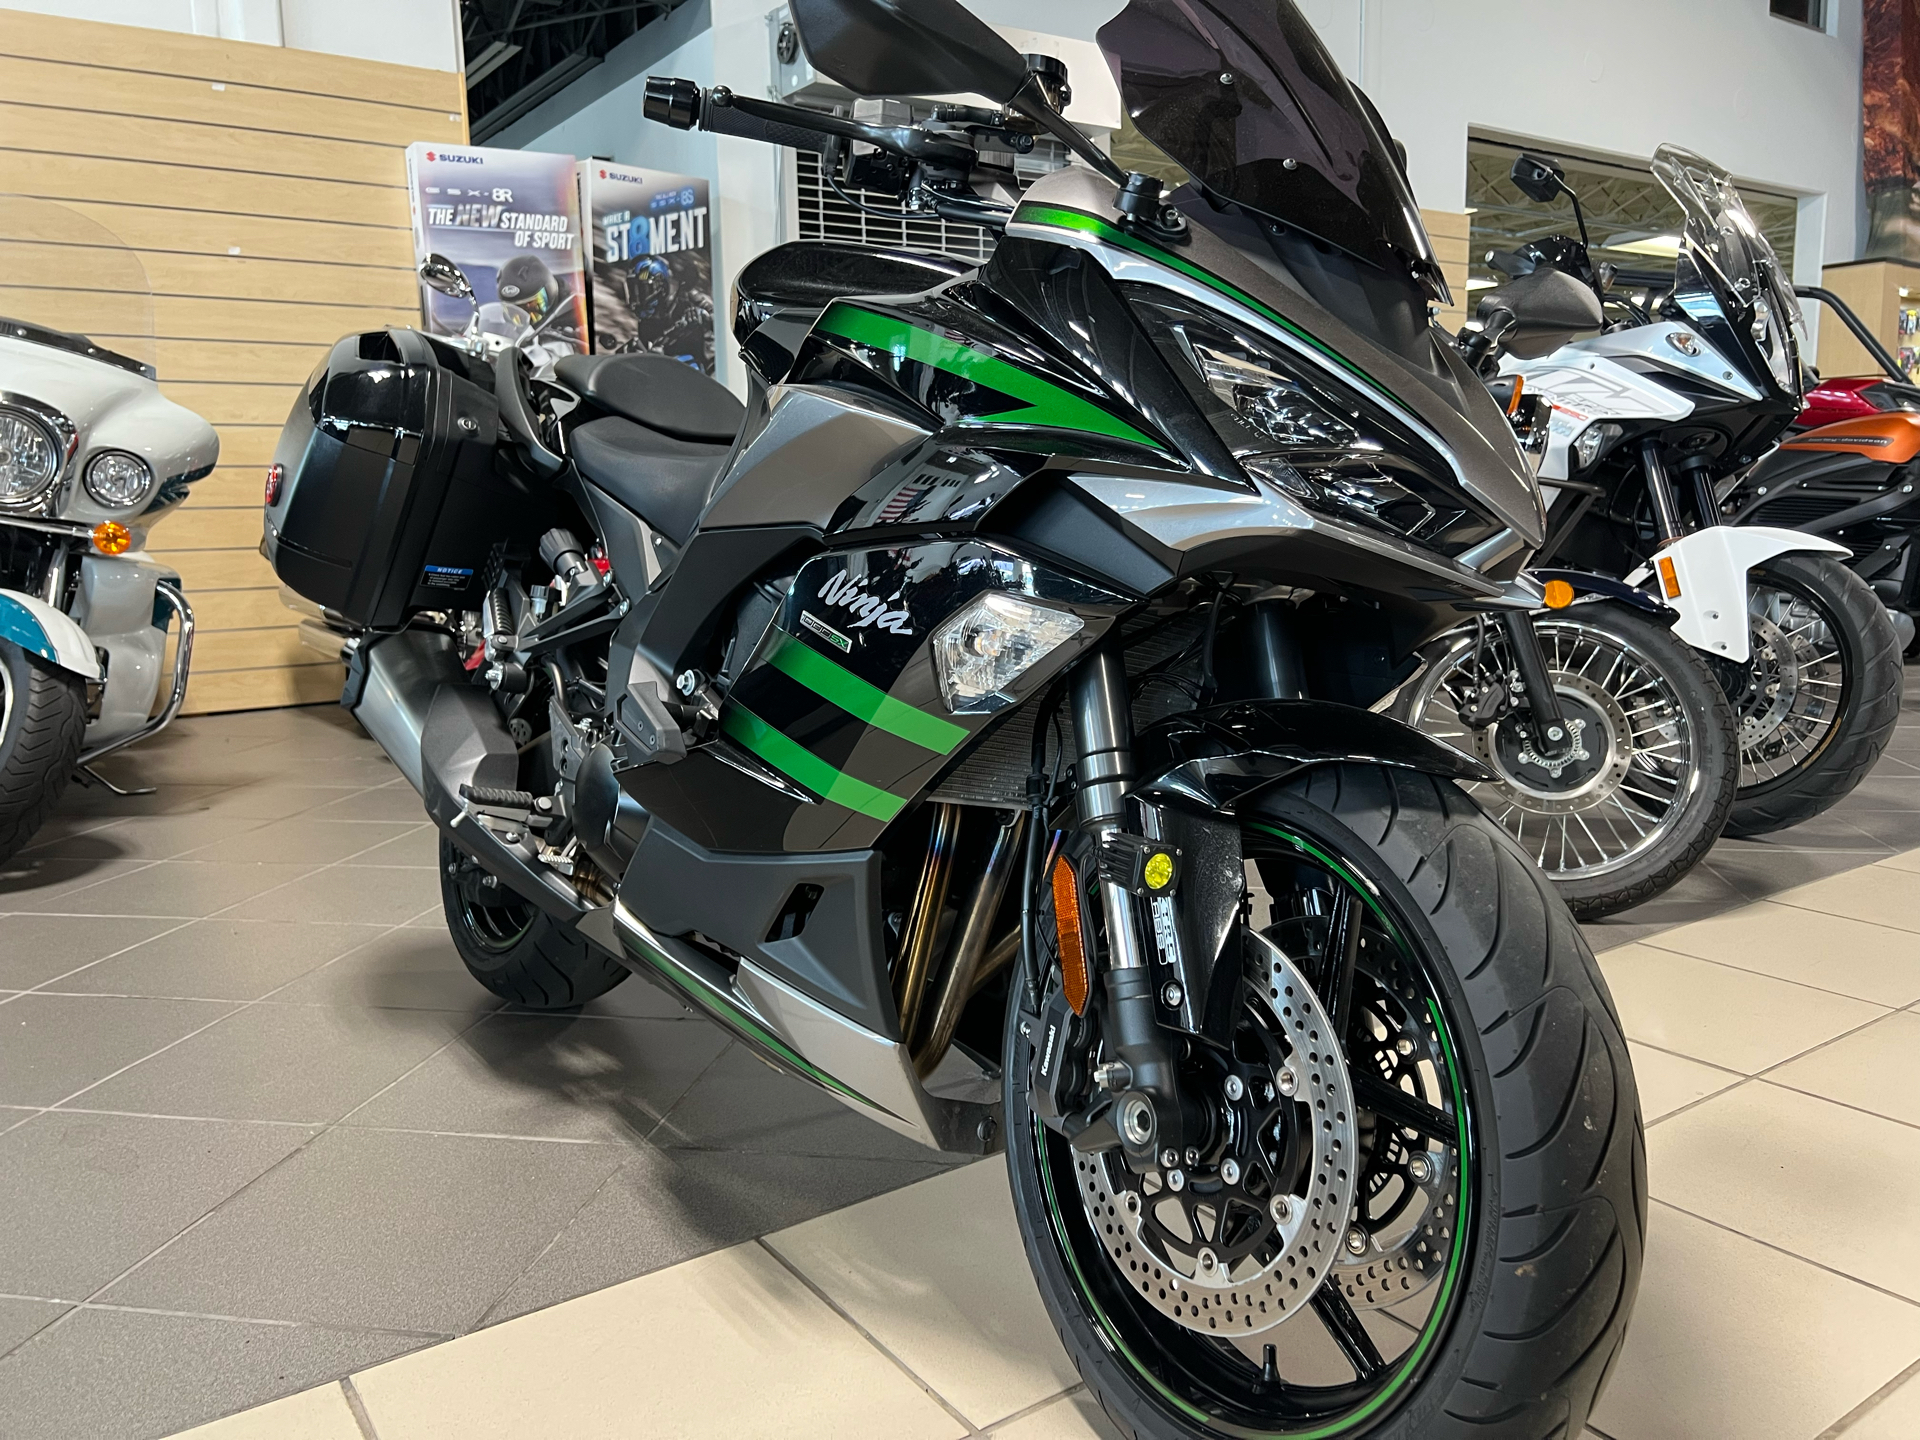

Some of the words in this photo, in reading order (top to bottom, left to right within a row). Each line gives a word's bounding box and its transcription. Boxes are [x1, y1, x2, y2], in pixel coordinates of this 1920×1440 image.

[439, 154, 484, 164] SUZUKI
[609, 172, 643, 184] SUZUKI
[428, 208, 454, 225] THE
[455, 204, 505, 228] NEW
[500, 212, 568, 232] STANDARD
[602, 212, 622, 225] MAKE
[624, 210, 630, 221] A
[514, 231, 531, 248] OF
[532, 233, 575, 250] SPORT
[606, 206, 708, 264] ST8MENT
[817, 568, 913, 636] Ninja
[1040, 1024, 1056, 1076] Kawasaki
